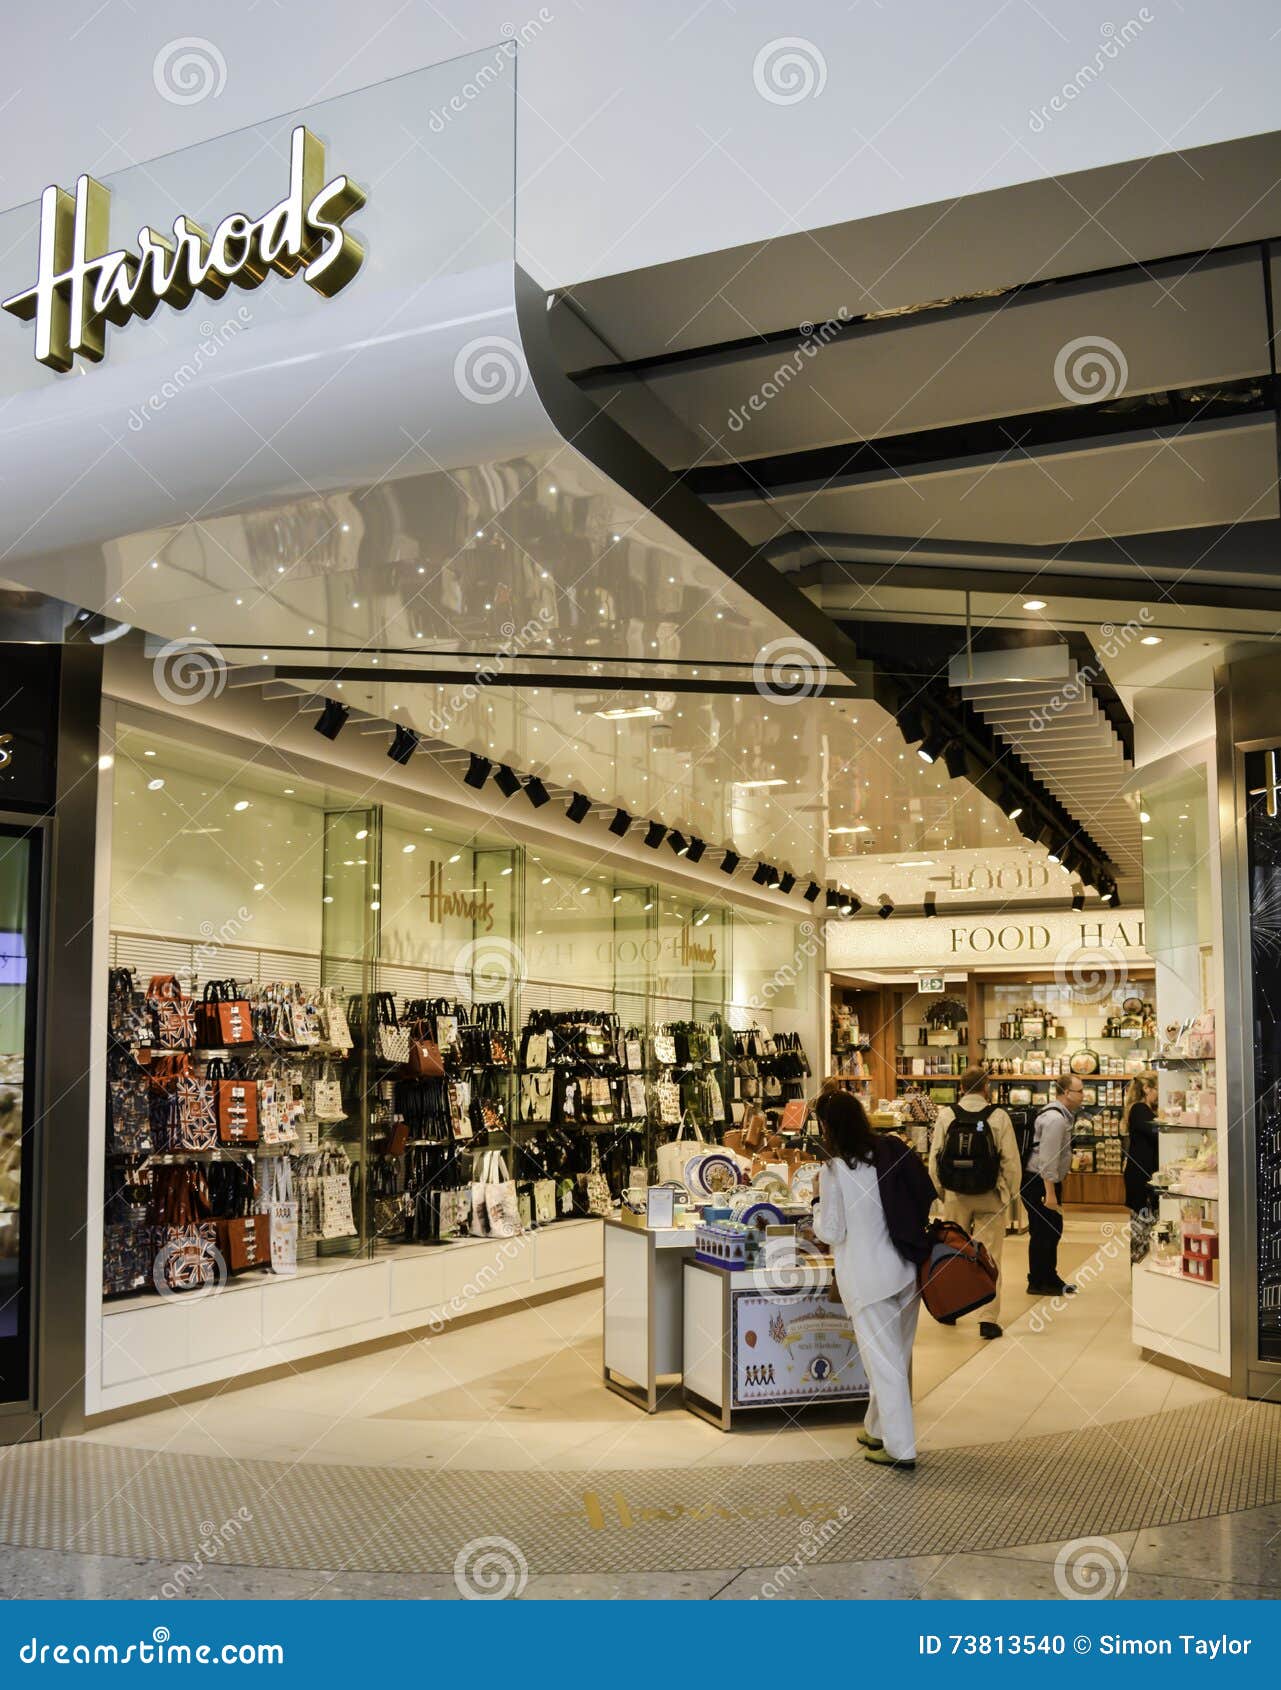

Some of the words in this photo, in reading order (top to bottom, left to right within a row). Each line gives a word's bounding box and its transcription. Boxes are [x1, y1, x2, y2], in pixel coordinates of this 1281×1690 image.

[2, 126, 366, 373] Harrods
[421, 860, 494, 932] Harrods
[951, 924, 1051, 952] FOOD
